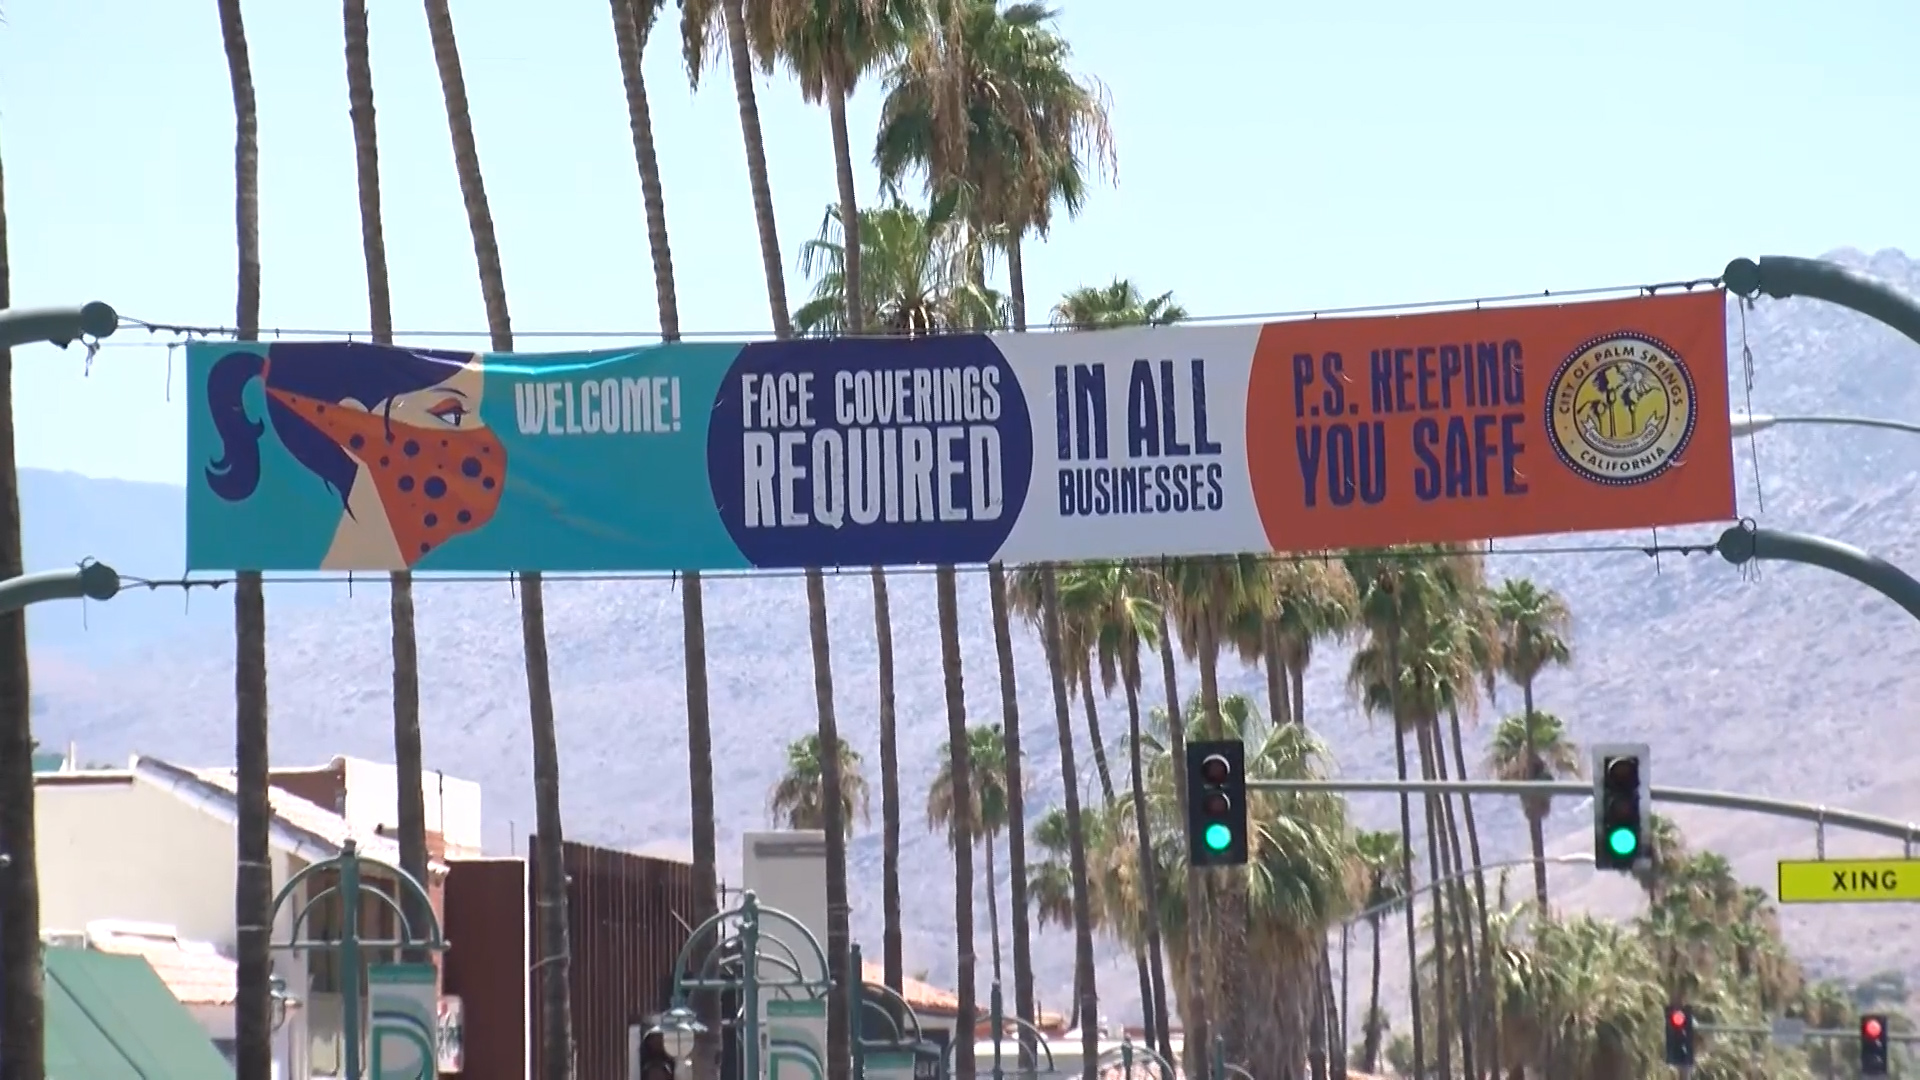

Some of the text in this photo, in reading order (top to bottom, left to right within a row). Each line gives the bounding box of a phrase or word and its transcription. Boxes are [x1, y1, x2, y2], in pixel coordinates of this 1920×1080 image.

[514, 376, 681, 435] WELCOME!
[741, 365, 1001, 428] FACE COVERINGS
[1055, 358, 1222, 460] IN ALL
[1293, 339, 1525, 418] P.S. KEEPING
[1559, 346, 1683, 414] CITY OF PALM SPRINGS
[743, 424, 1003, 530] REQUIRED
[1058, 462, 1223, 516] BUSINESSES
[1296, 413, 1528, 507] YOU SAFE
[1580, 446, 1666, 473] CALIFORNIA
[1833, 870, 1898, 891] XING
